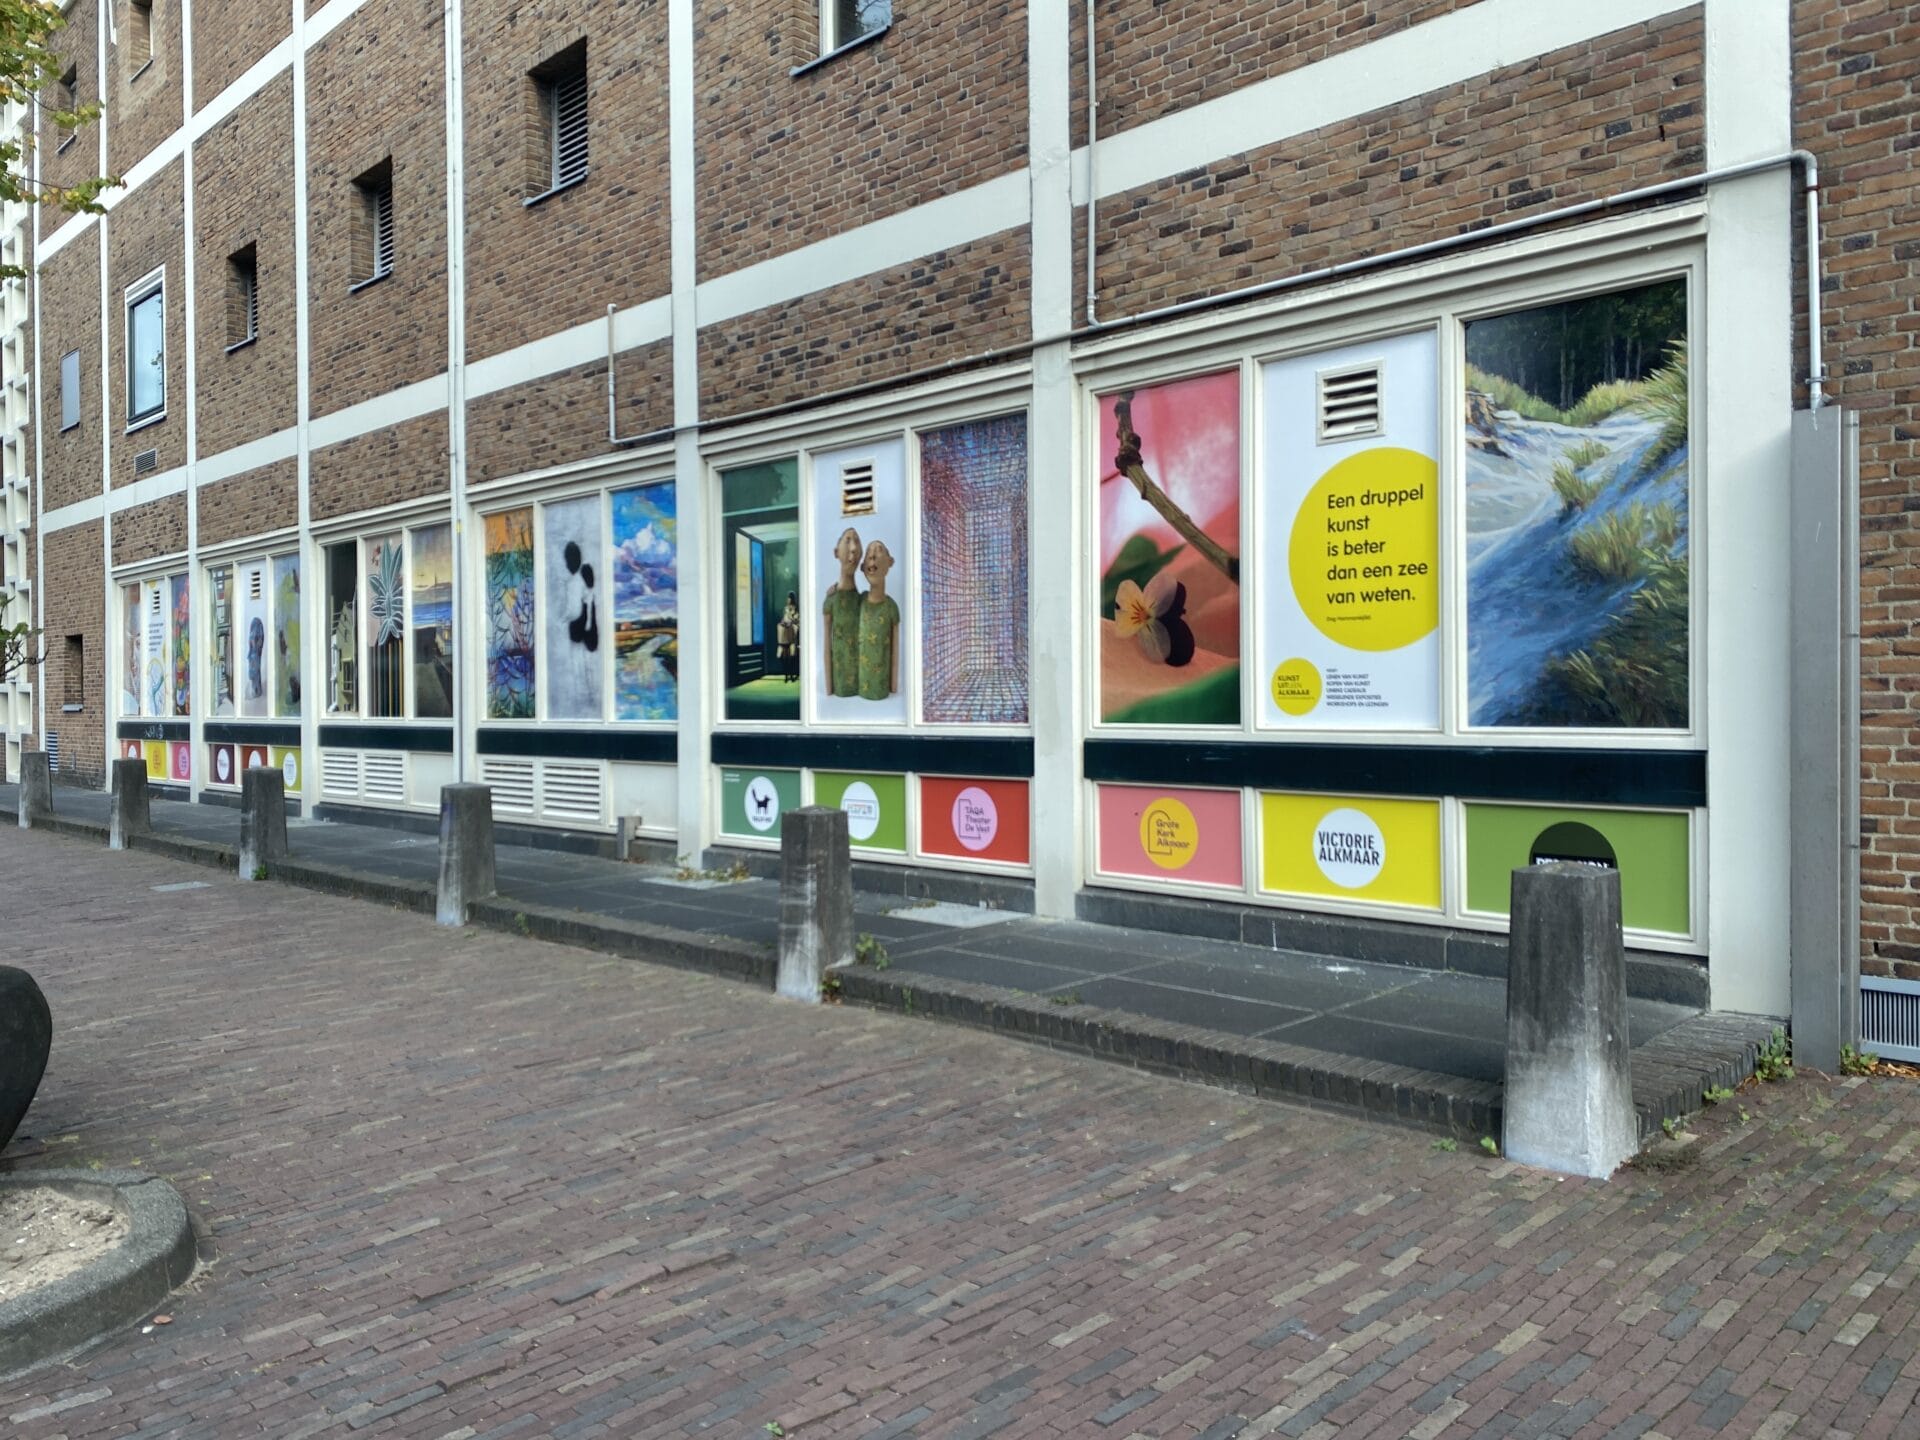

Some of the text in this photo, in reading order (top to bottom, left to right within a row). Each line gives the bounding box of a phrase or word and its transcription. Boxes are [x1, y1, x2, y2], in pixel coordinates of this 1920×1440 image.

[1328, 483, 1424, 509] Een druppel
[1328, 515, 1370, 533] kunst
[1327, 540, 1386, 557] is beter
[1327, 562, 1428, 580] dan een zee
[1327, 587, 1415, 604] van weten.
[965, 806, 984, 815] TAQA
[965, 815, 991, 824] Theater
[965, 824, 974, 832] De
[1156, 819, 1179, 828] Grote
[1157, 829, 1175, 838] Kerk
[1319, 831, 1375, 850] VICTORIE
[1157, 838, 1190, 848] Alkmaar
[1319, 847, 1380, 866] ALKMAAR
